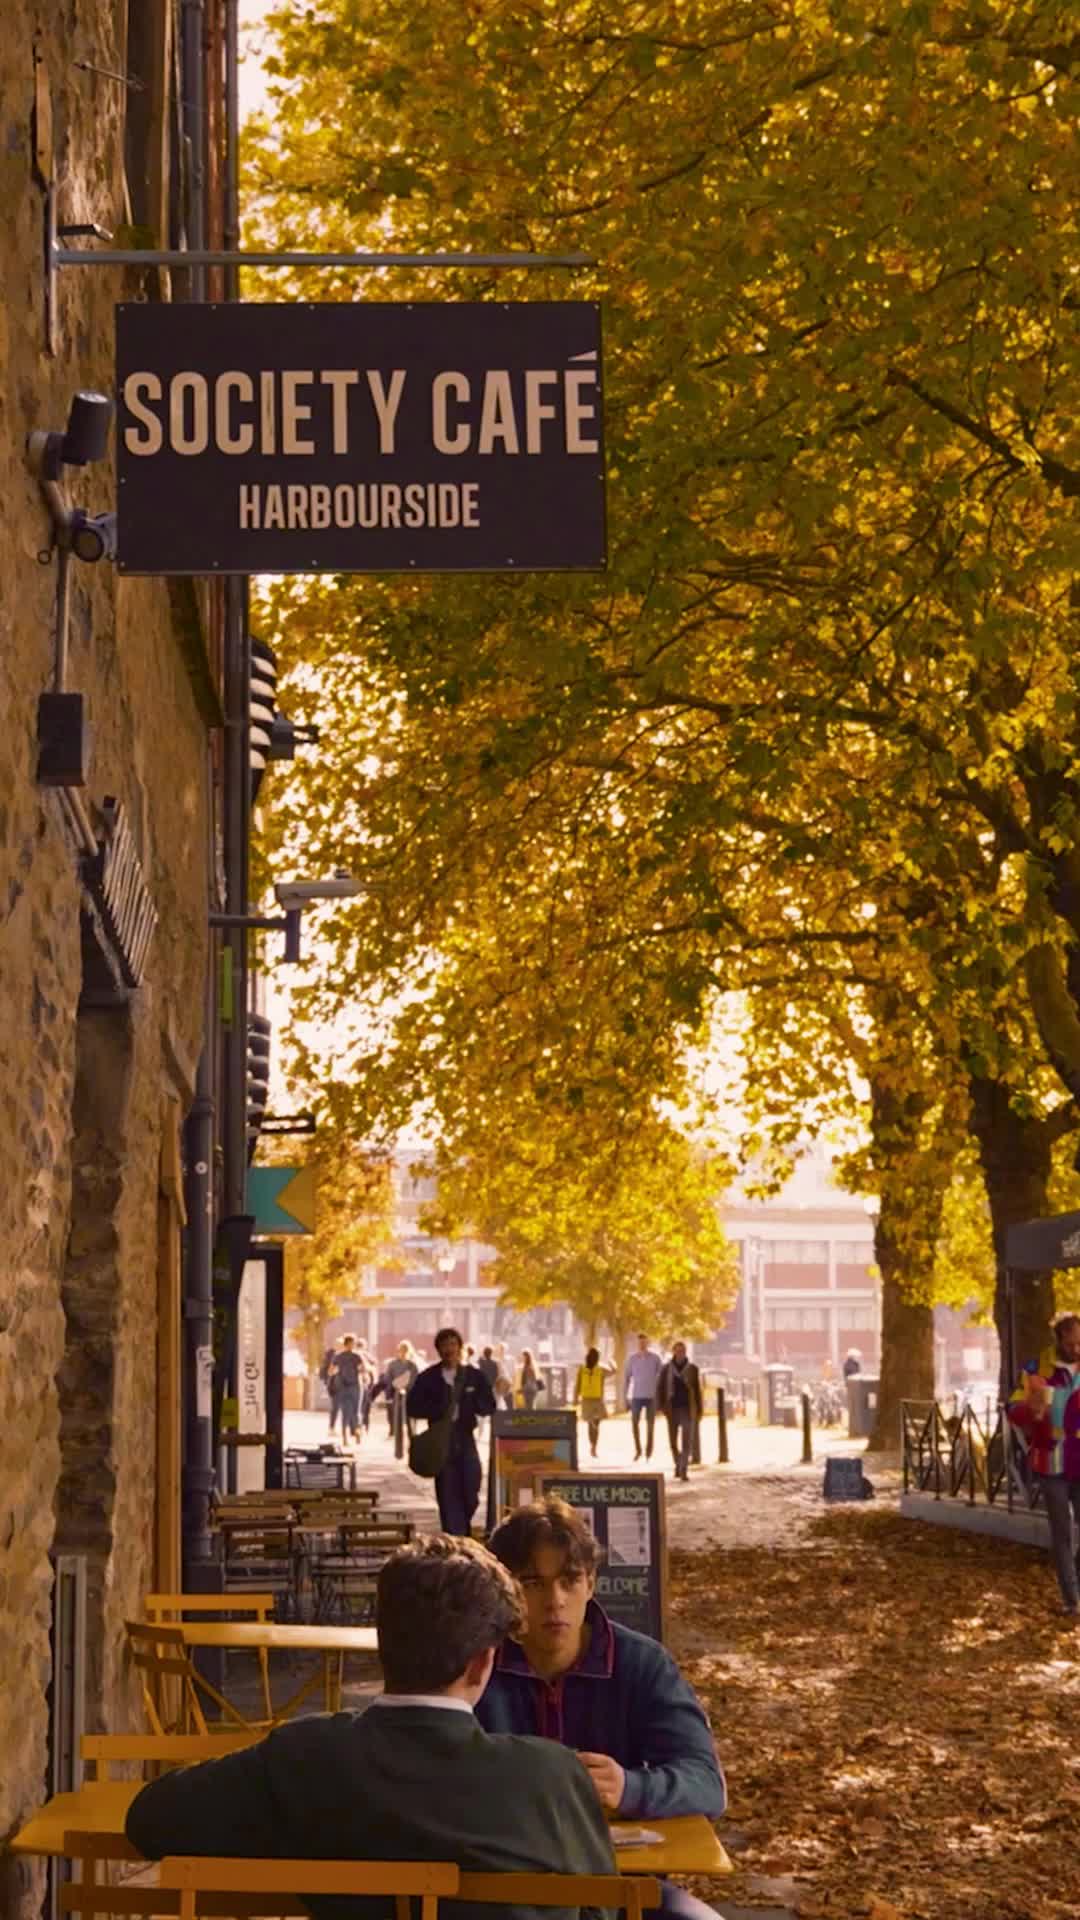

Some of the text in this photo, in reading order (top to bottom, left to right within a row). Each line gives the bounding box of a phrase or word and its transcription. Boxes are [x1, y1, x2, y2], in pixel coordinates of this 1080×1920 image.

[123, 350, 599, 455] SOCIETY CAFÉ
[239, 482, 480, 529] HARBOURSIDE
[611, 1486, 651, 1504] MUSIC
